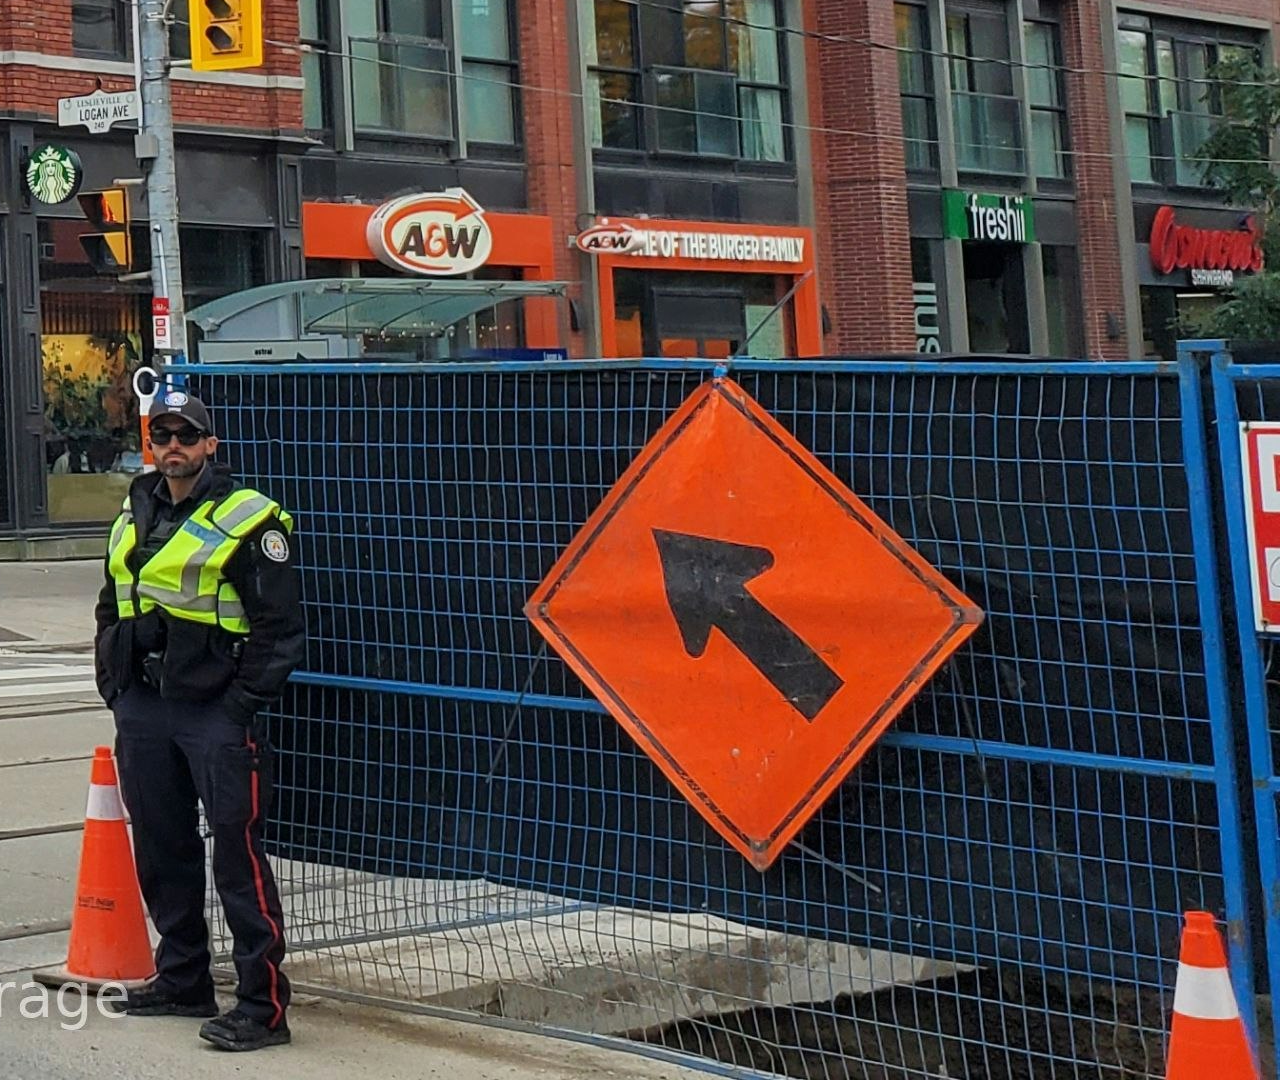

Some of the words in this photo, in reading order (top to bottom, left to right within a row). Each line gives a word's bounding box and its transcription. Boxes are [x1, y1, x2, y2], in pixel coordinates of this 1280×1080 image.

[77, 96, 121, 108] LESLIEVILLE
[79, 108, 109, 122] LOGAN
[112, 104, 129, 118] AVE
[971, 193, 1026, 242] freshii
[398, 222, 481, 259] A&W
[586, 235, 632, 249] A&W
[659, 230, 681, 258] OF
[682, 231, 710, 258] THE
[710, 233, 762, 261] BURGER
[762, 236, 805, 264] FAMILY
